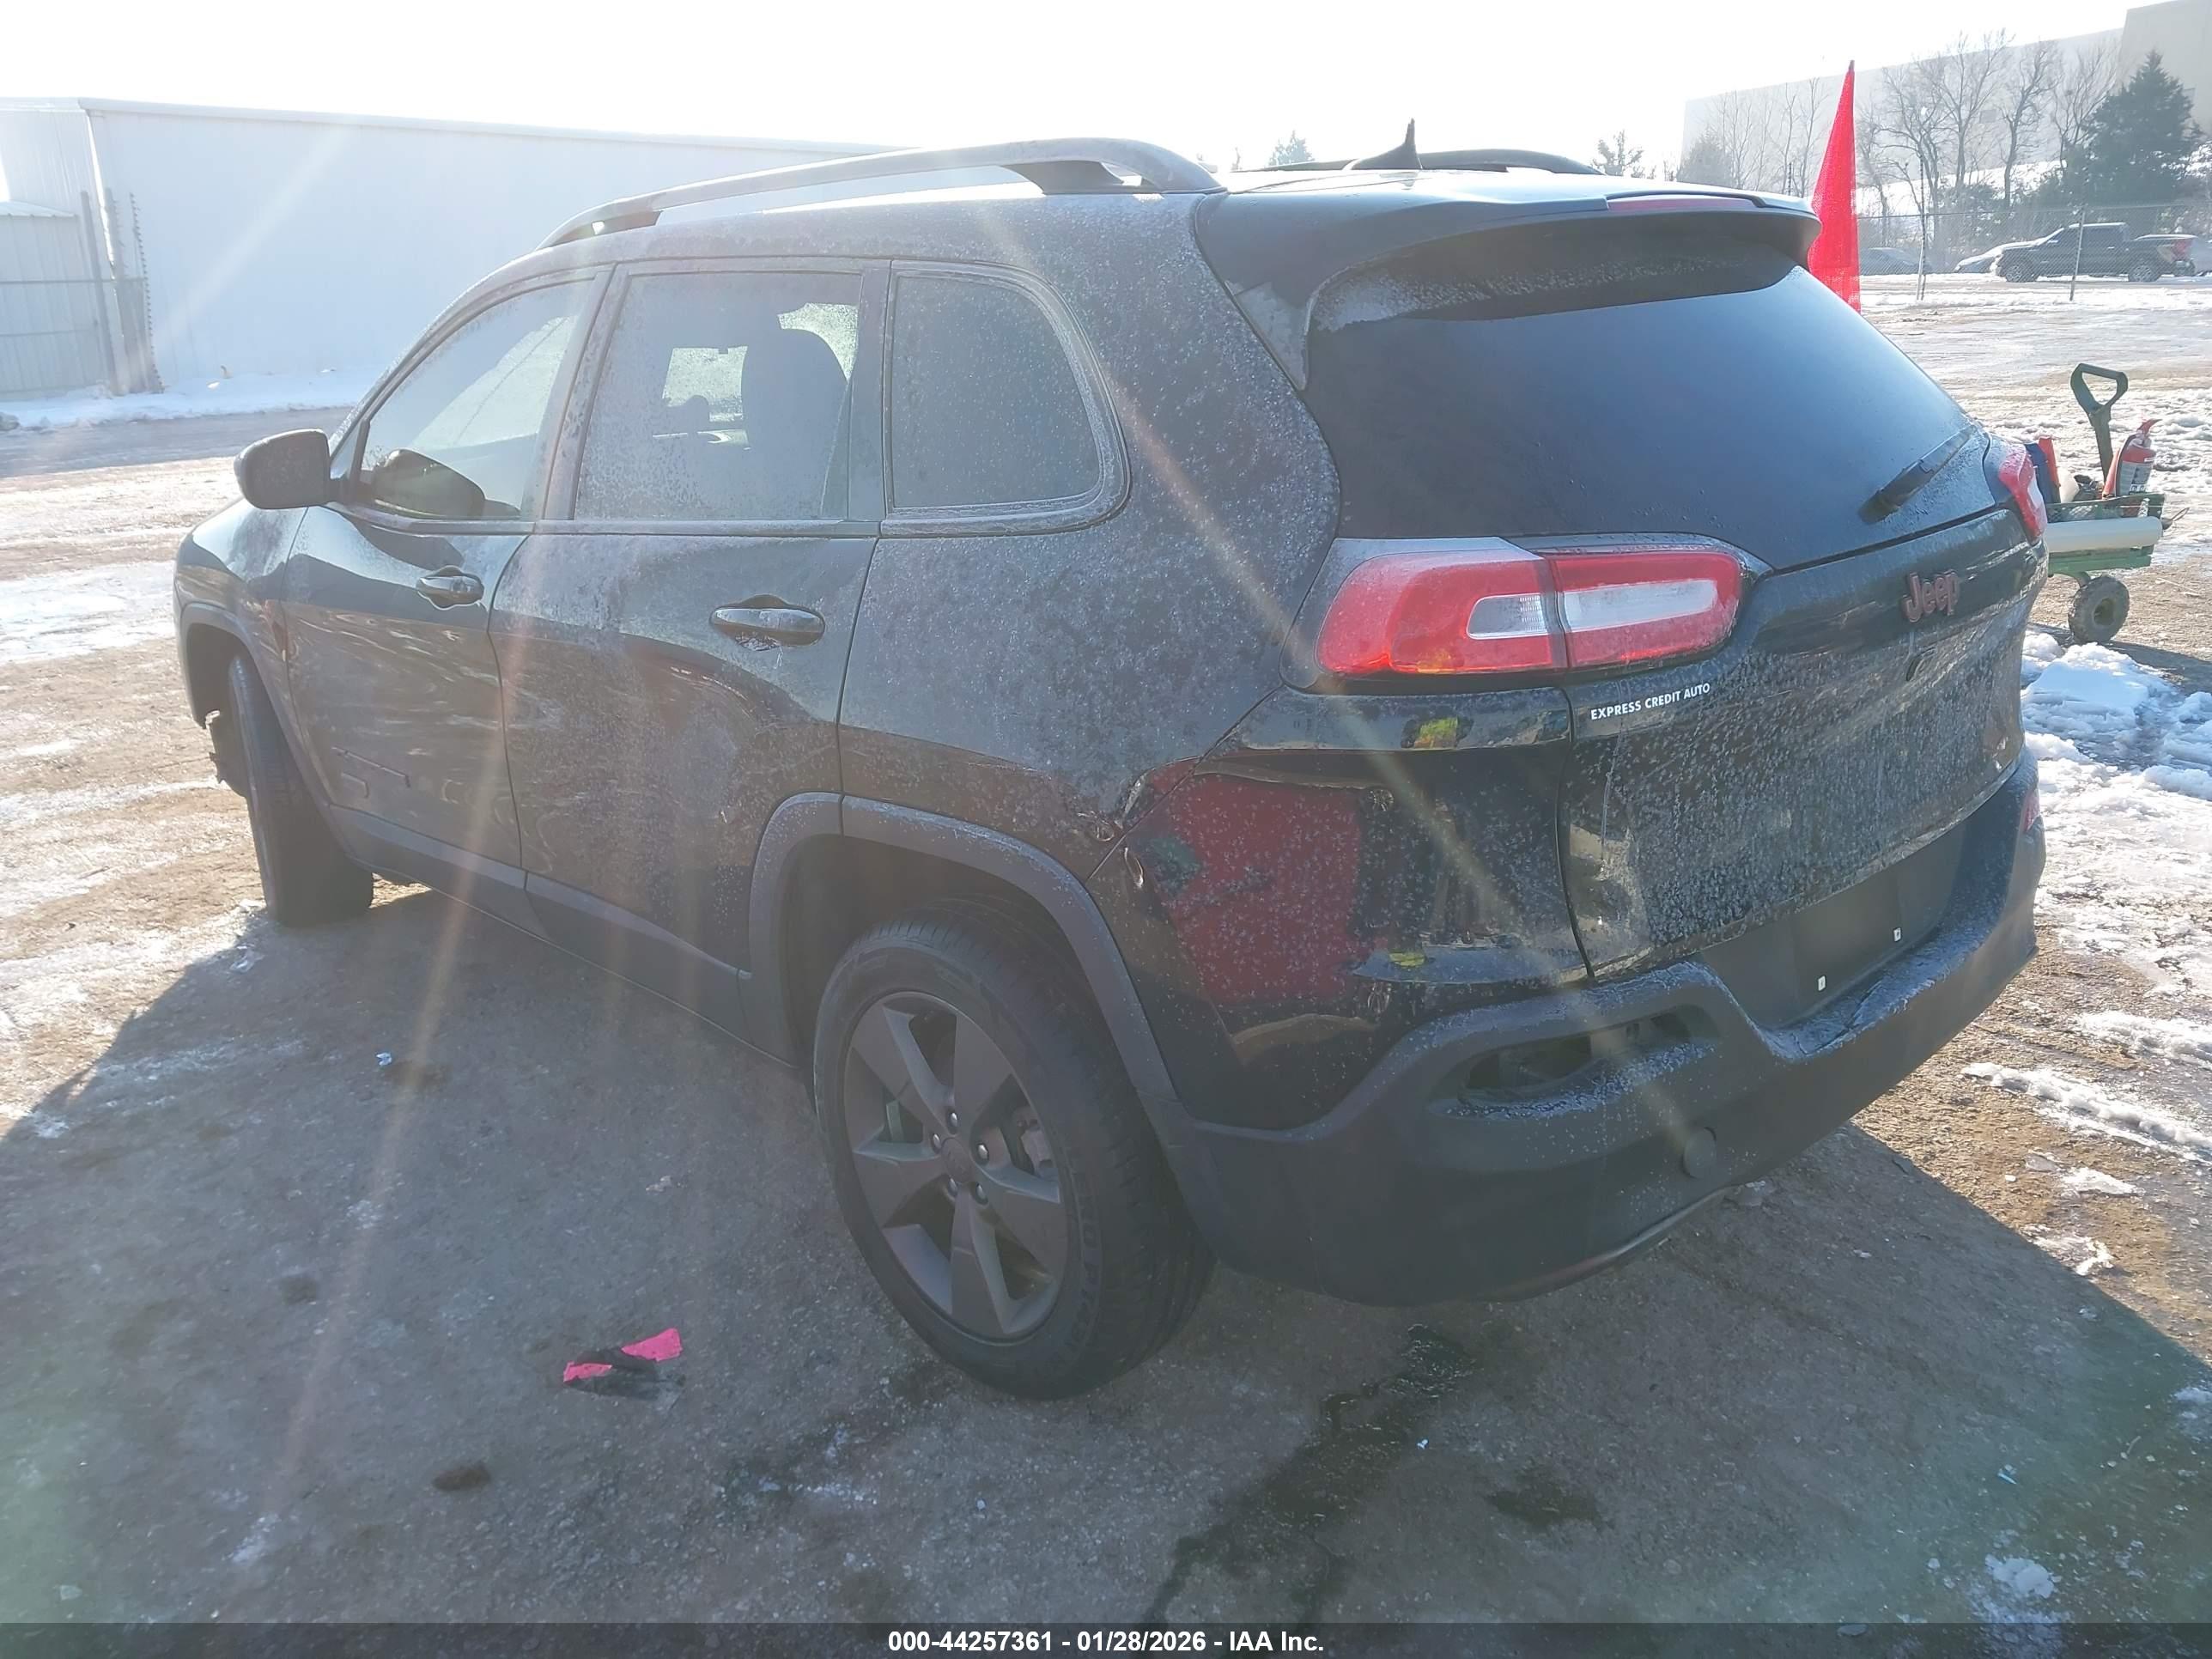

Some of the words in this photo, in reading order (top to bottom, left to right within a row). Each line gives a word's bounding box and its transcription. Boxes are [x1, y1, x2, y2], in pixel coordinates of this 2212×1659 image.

[1901, 569, 1960, 623] Jeep
[1590, 700, 1642, 720] EXPRESS
[1644, 690, 1681, 708] CREDIT
[1683, 683, 1711, 700] AUTO
